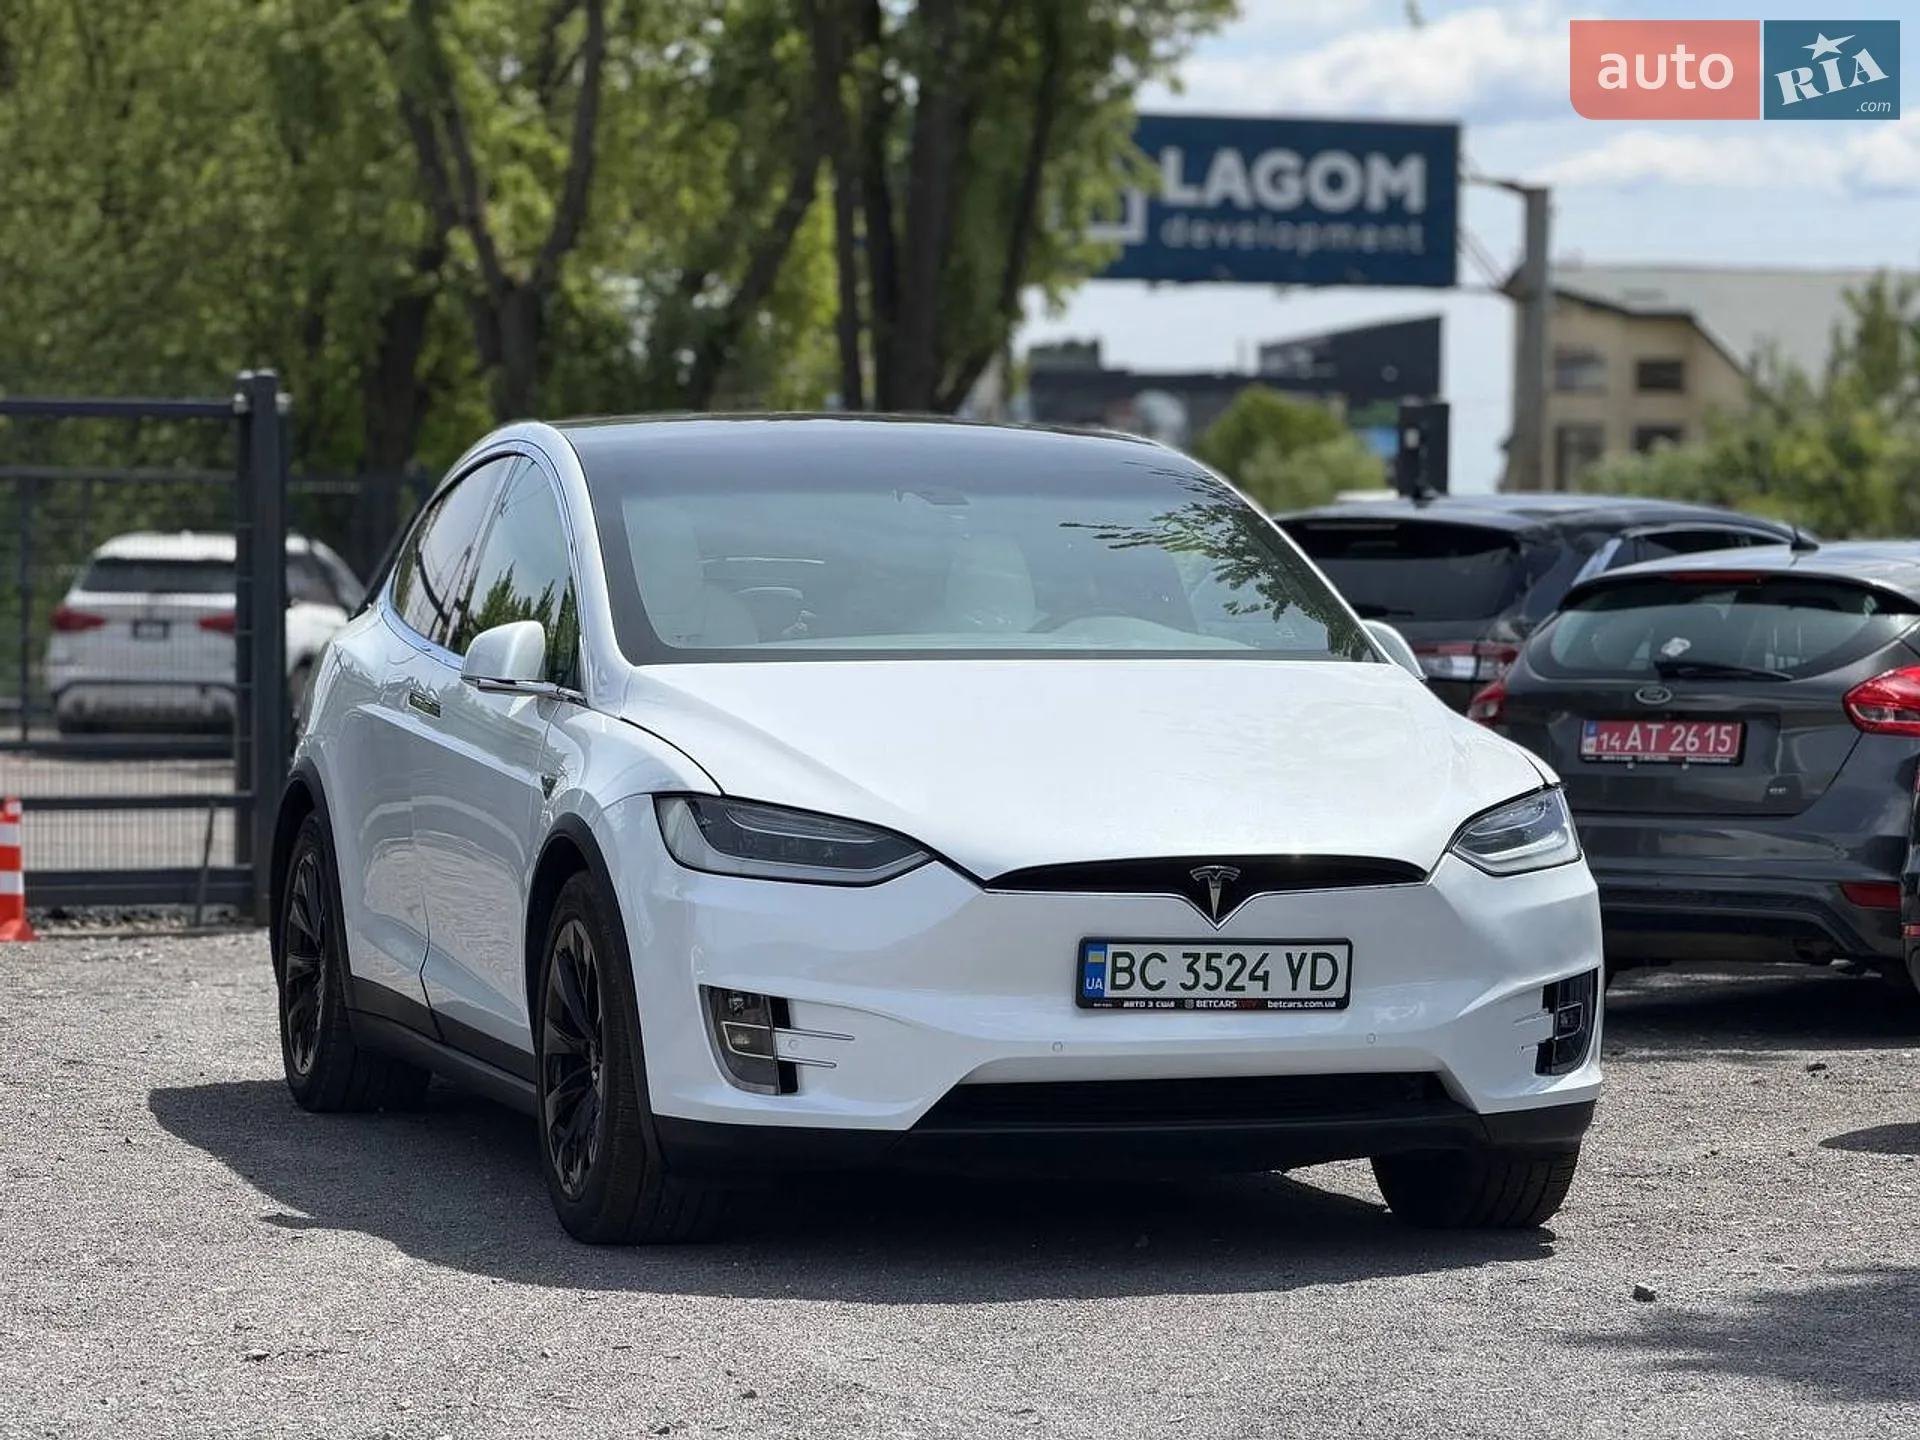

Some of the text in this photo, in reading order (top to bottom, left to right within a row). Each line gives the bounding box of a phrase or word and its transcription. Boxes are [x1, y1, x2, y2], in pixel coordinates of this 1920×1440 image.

[1160, 145, 1427, 215] LAGOM
[1159, 213, 1426, 257] development
[1669, 725, 1733, 753] 2615
[1086, 978, 1104, 990] UA
[1110, 951, 1339, 992] BC 3524 YD
[1196, 1000, 1238, 1008] BETCARS
[1267, 1000, 1337, 1009] betcars.com.ua
